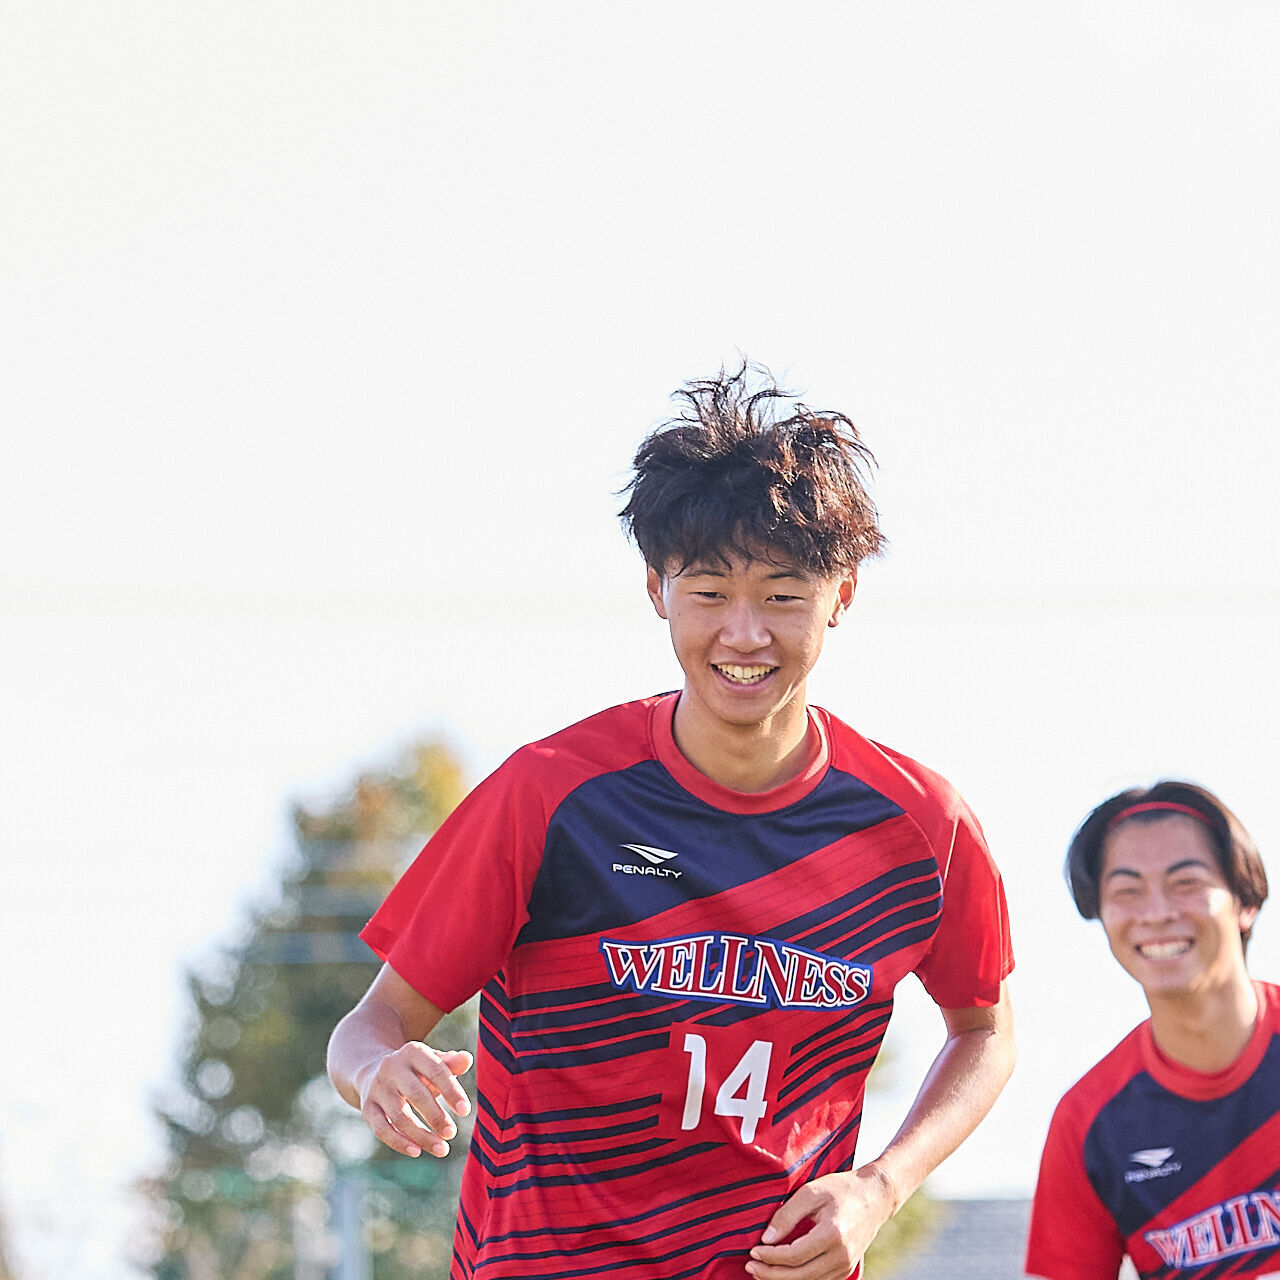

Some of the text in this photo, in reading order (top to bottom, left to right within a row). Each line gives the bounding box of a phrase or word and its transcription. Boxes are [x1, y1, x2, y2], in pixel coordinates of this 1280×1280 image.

[612, 863, 683, 879] PENALTY
[601, 933, 871, 1008] WELLNESS
[681, 1032, 773, 1145] 14
